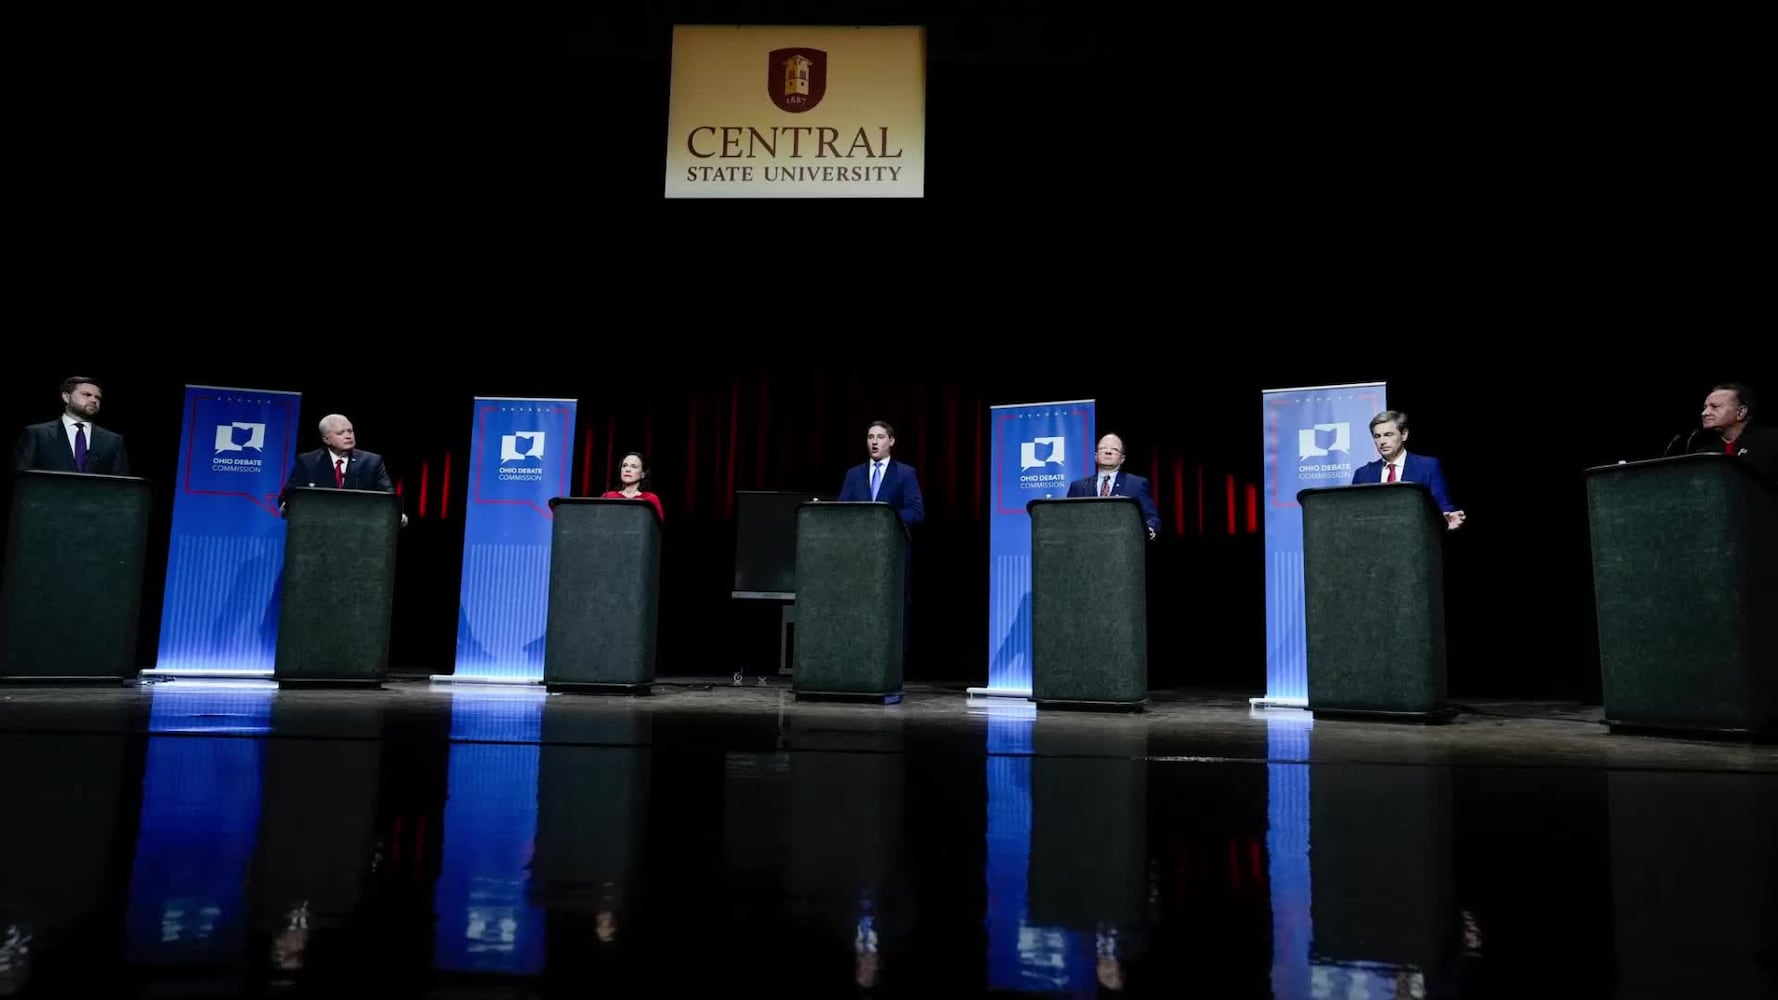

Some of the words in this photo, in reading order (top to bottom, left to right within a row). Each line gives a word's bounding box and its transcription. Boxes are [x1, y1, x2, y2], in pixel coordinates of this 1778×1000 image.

[785, 96, 807, 105] 1887
[687, 126, 903, 159] CENTRAL
[687, 166, 753, 182] STATE
[764, 166, 903, 182] UNIVERSITY
[212, 457, 233, 465] OHIO
[234, 458, 262, 466] DEBATE
[212, 464, 262, 473] COMMISSION
[1321, 463, 1350, 471] DEBATE
[1298, 471, 1351, 480] COMMISSION
[1020, 481, 1065, 489] COMMISSION
